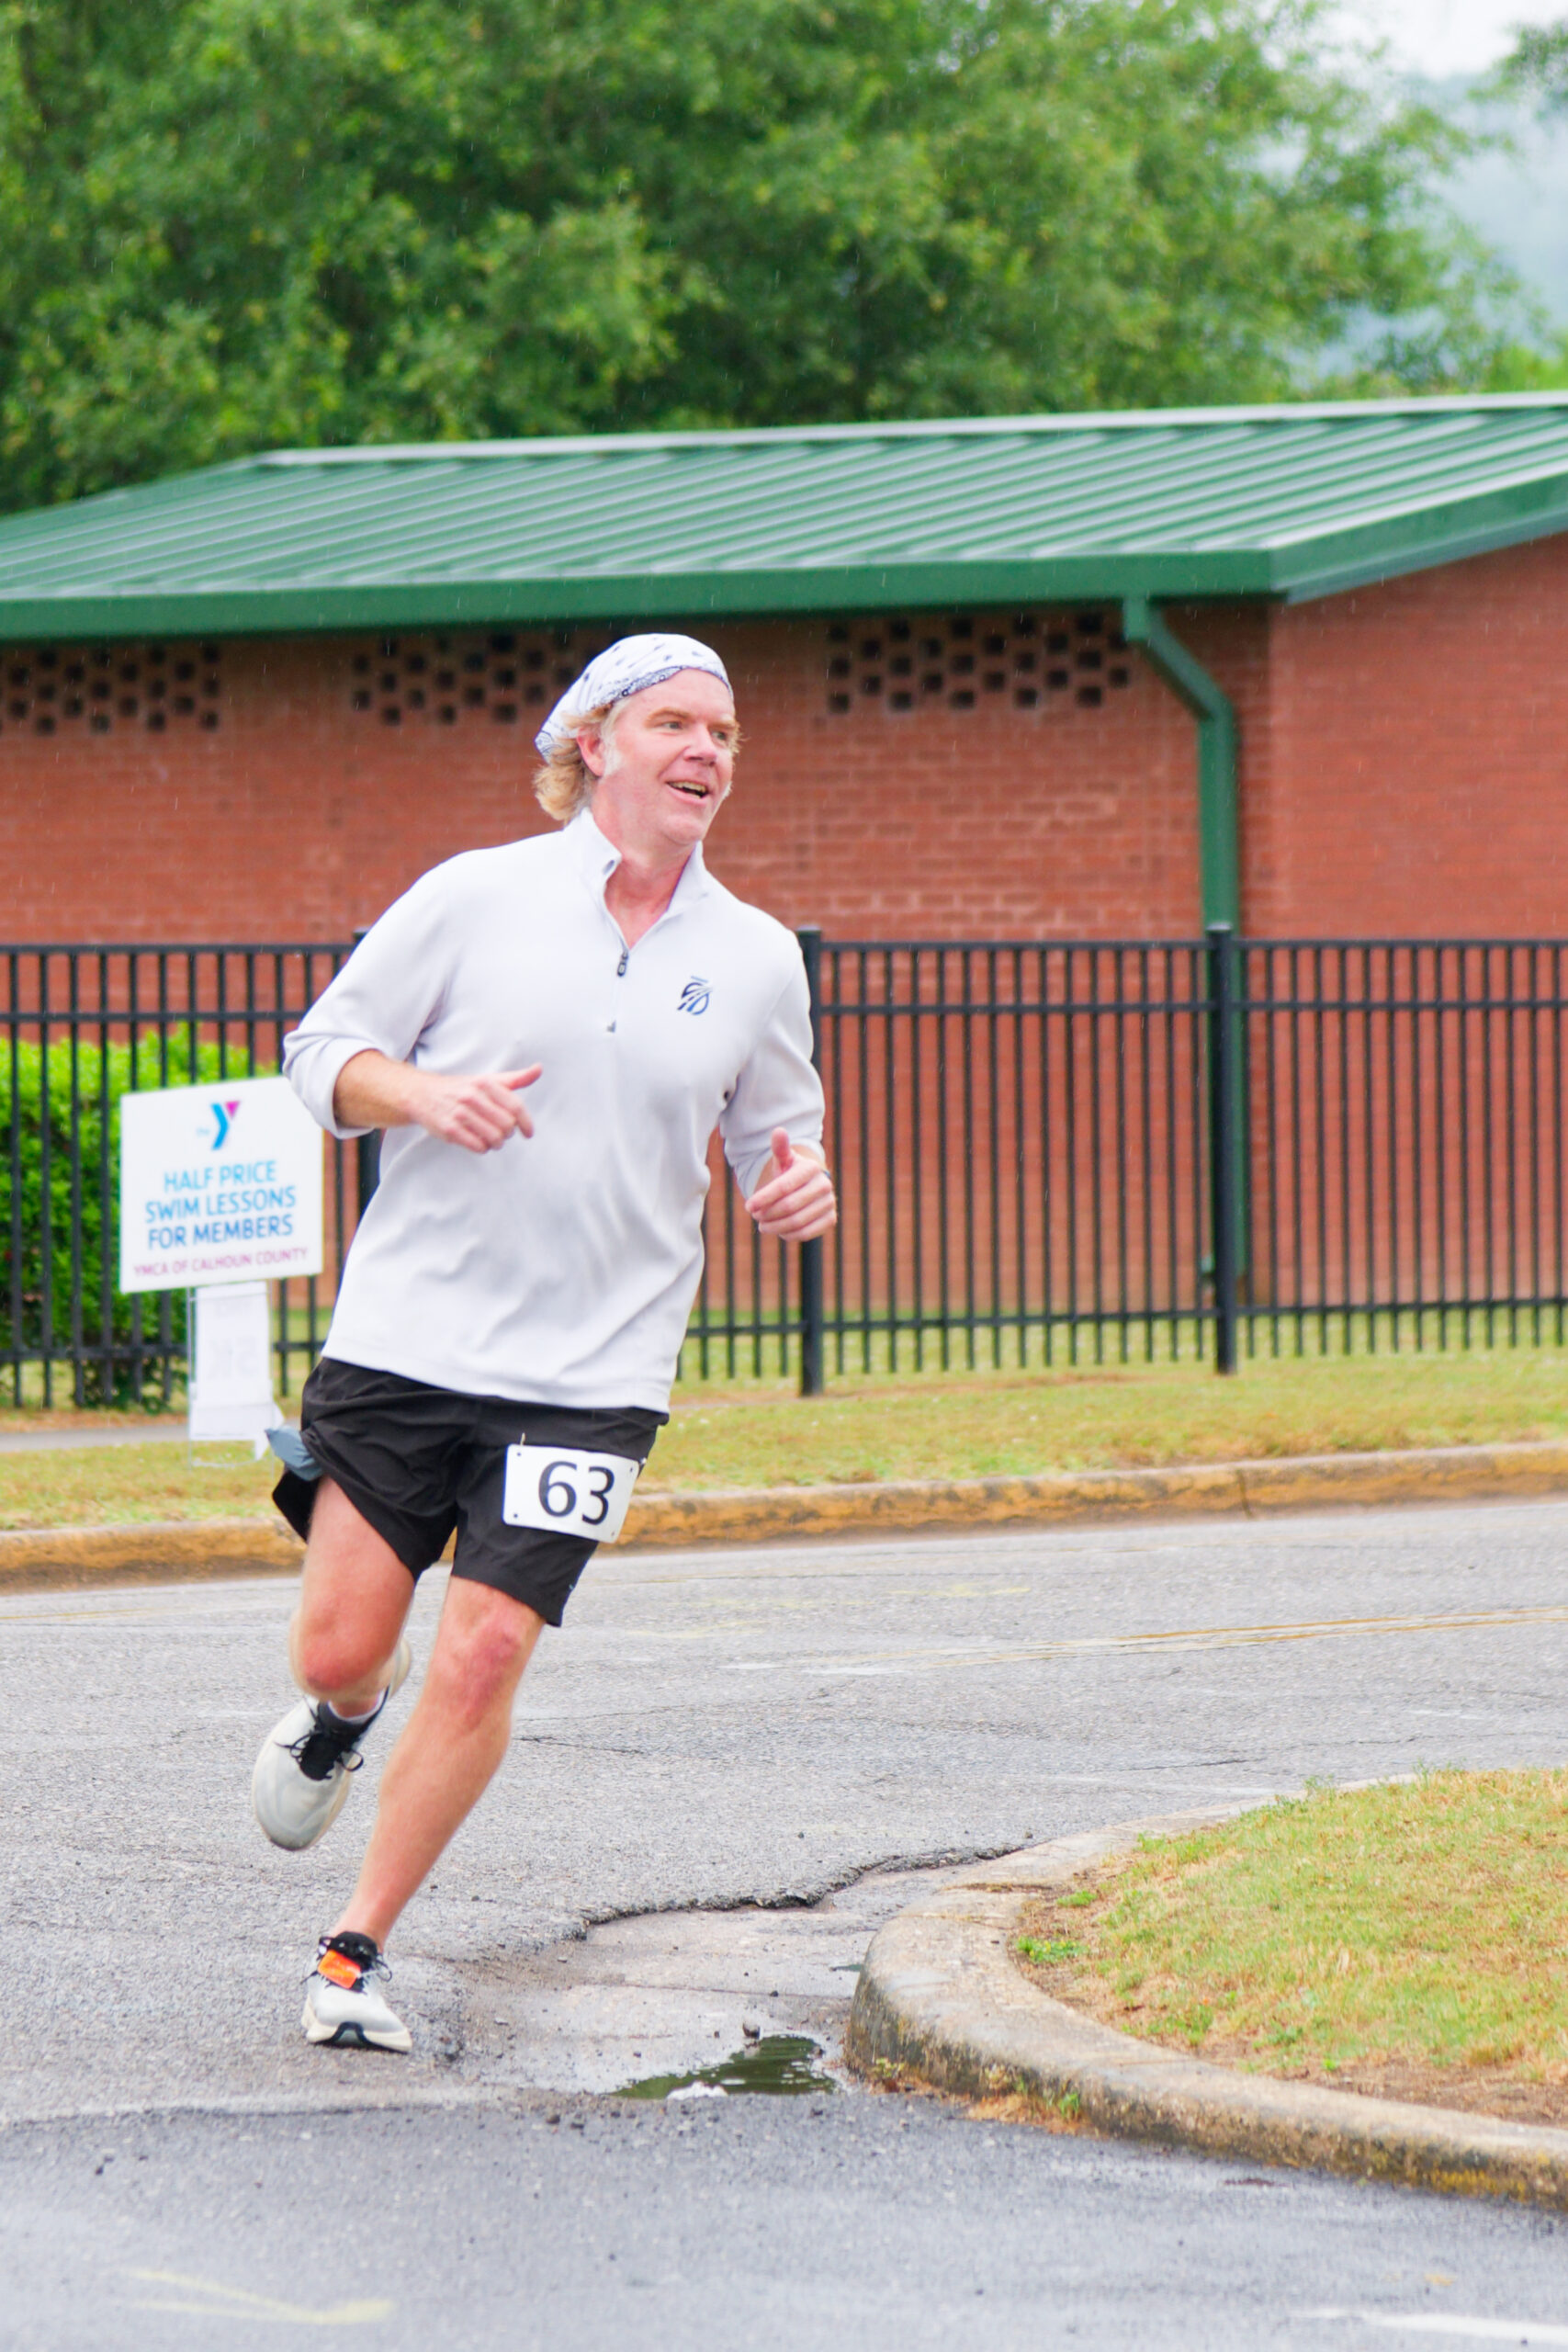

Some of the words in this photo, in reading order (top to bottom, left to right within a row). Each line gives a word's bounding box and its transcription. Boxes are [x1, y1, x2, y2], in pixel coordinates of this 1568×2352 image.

[164, 1167, 213, 1193] HALF
[220, 1160, 276, 1187] PRICE
[146, 1197, 200, 1224] SWIM
[206, 1185, 297, 1216] LESSONS
[148, 1226, 187, 1250] FOR
[193, 1214, 293, 1245] MEMBERS
[134, 1261, 169, 1276] YMCA
[173, 1259, 187, 1274] OF
[192, 1252, 252, 1272] CALHOUN
[256, 1246, 308, 1266] COUNTY
[538, 1461, 615, 1526] 63
